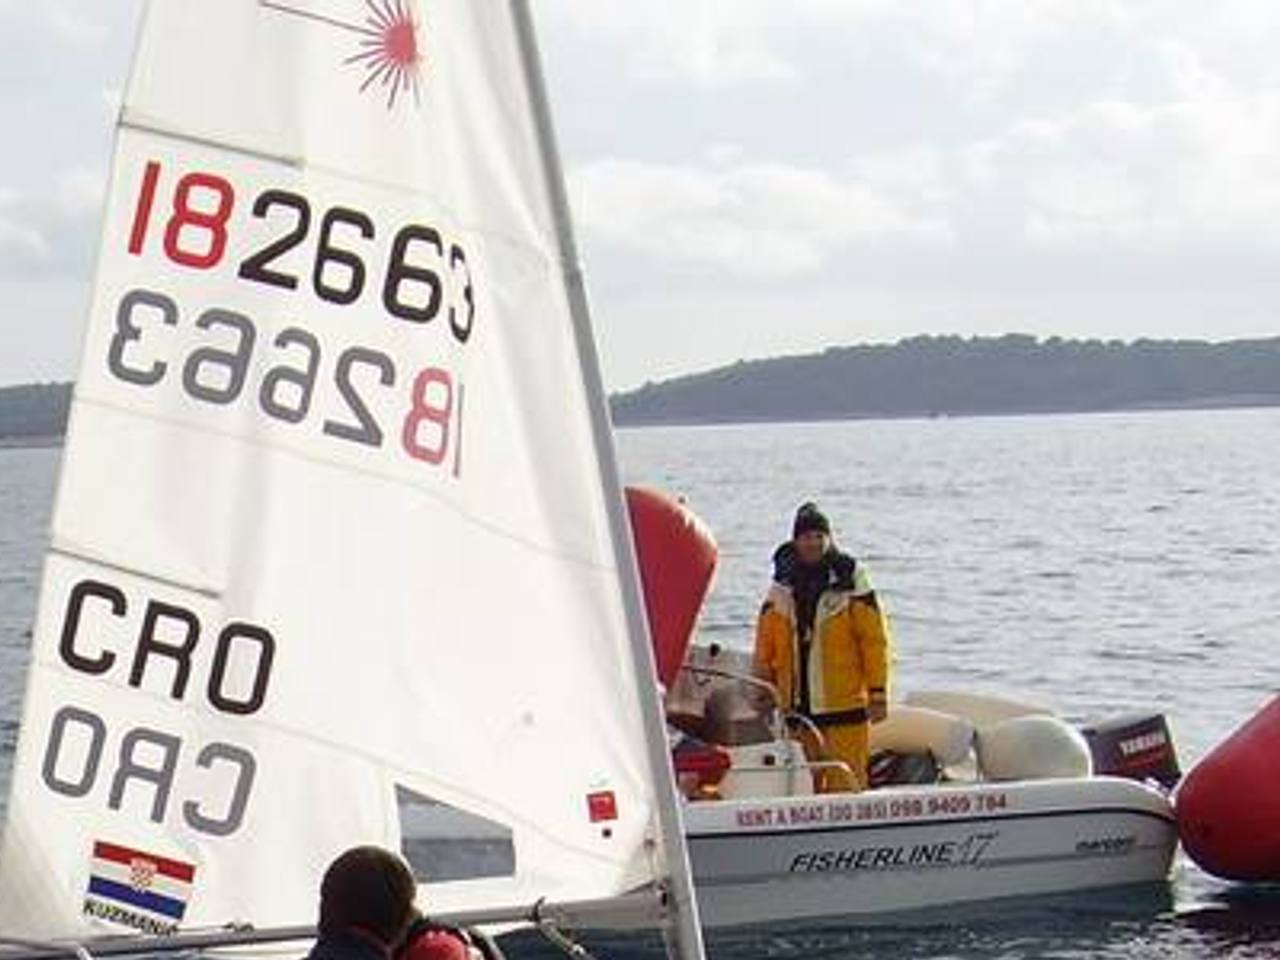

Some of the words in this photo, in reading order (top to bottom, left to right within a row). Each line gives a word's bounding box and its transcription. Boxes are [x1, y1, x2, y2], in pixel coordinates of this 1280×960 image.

[127, 160, 476, 344] 182663
[59, 579, 276, 716] CRO
[790, 803, 824, 822] BOAT
[791, 841, 958, 873] FISHERLINE
